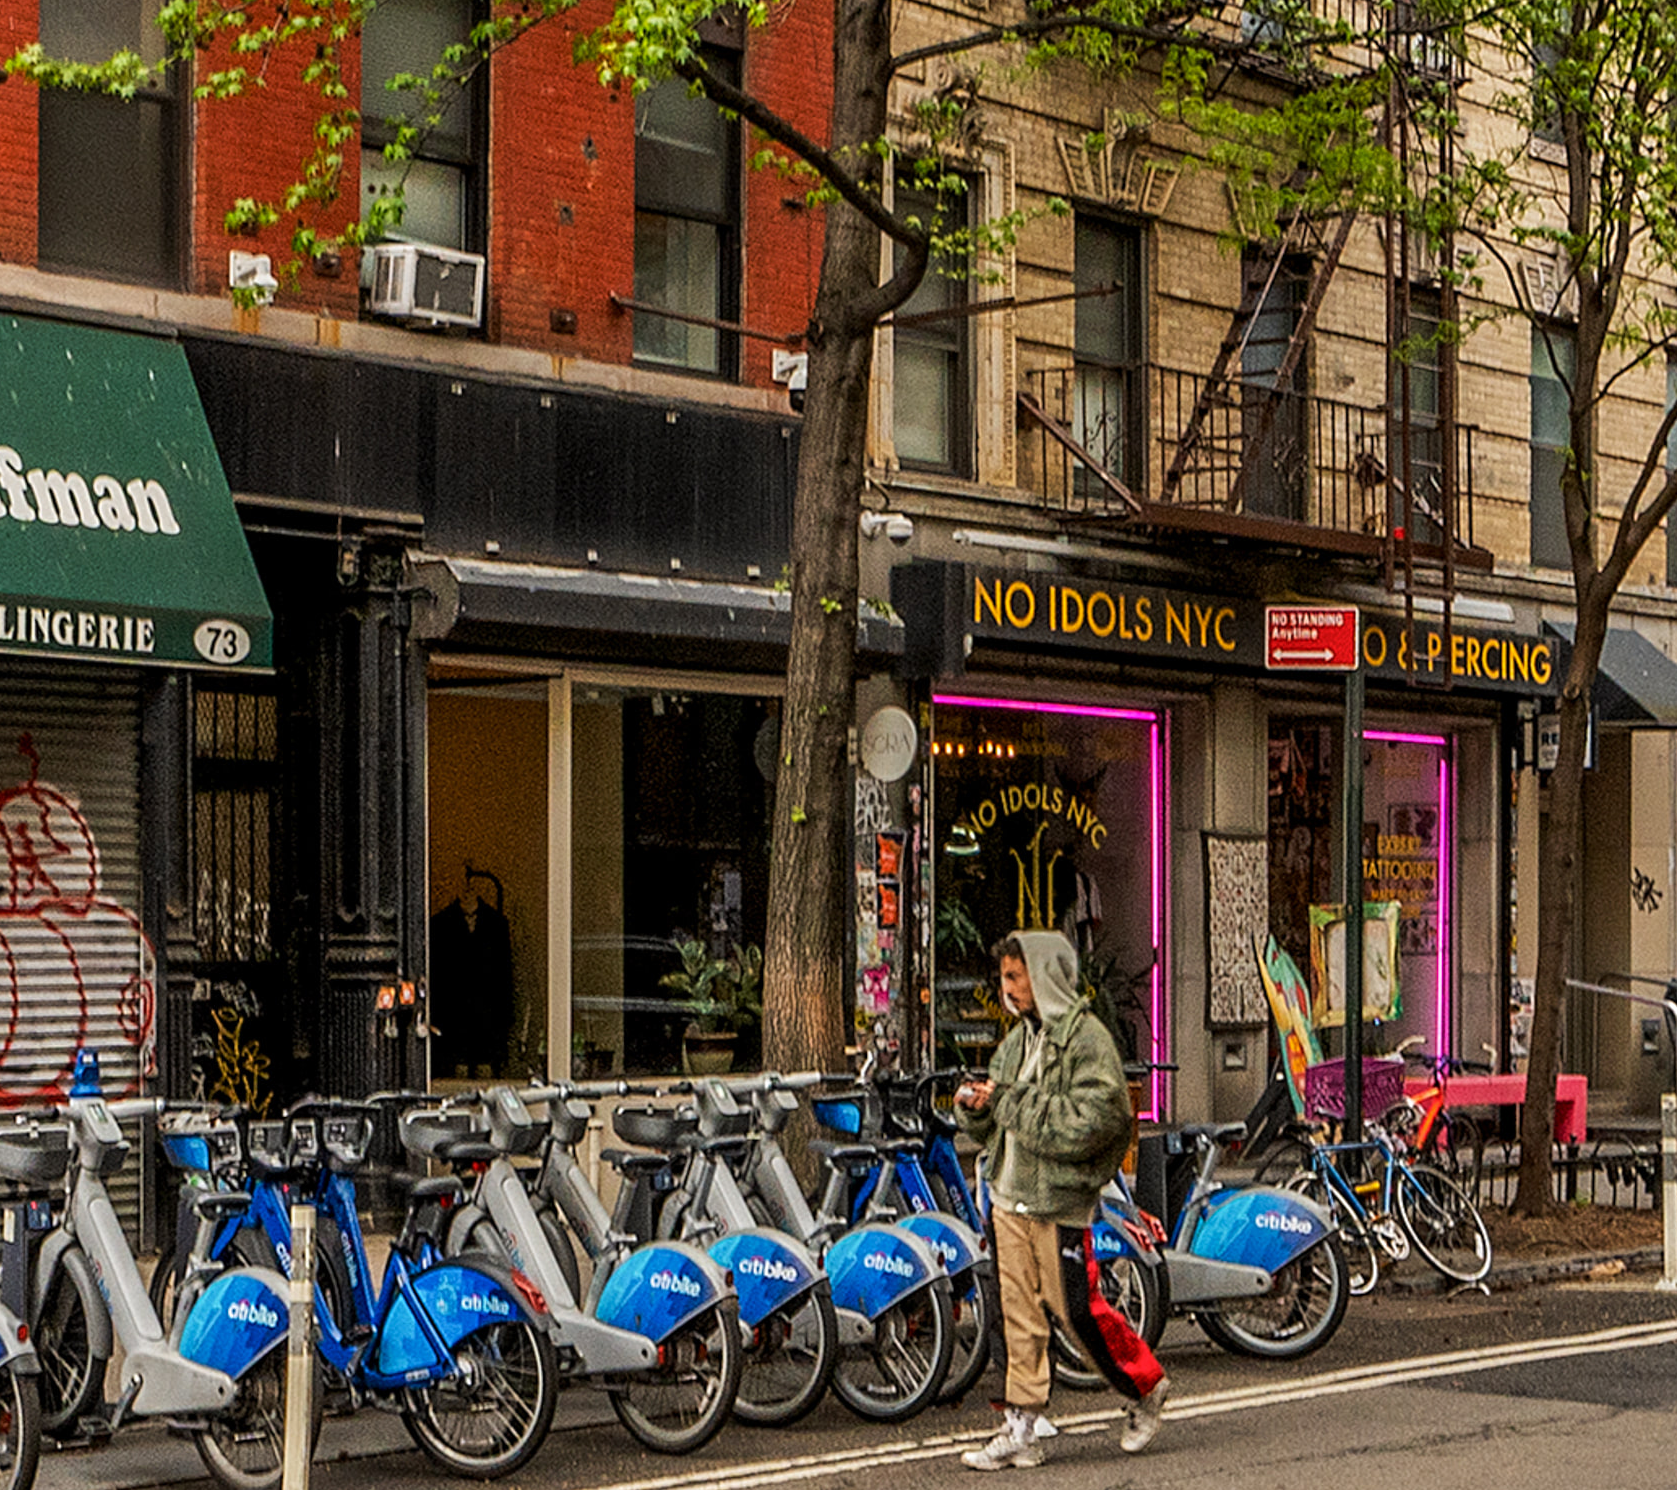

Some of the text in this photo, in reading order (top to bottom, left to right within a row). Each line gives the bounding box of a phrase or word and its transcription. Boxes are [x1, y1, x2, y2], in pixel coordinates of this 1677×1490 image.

[974, 576, 1036, 629] NO
[1049, 585, 1154, 642] IDOLS
[1165, 598, 1237, 651] NYC
[1427, 630, 1552, 686] PERCING
[1271, 612, 1344, 627] NO STANDING
[1272, 626, 1318, 642] Anytime
[206, 626, 238, 658] 73
[999, 782, 1064, 817] IDOLS
[1066, 794, 1108, 851] NYC
